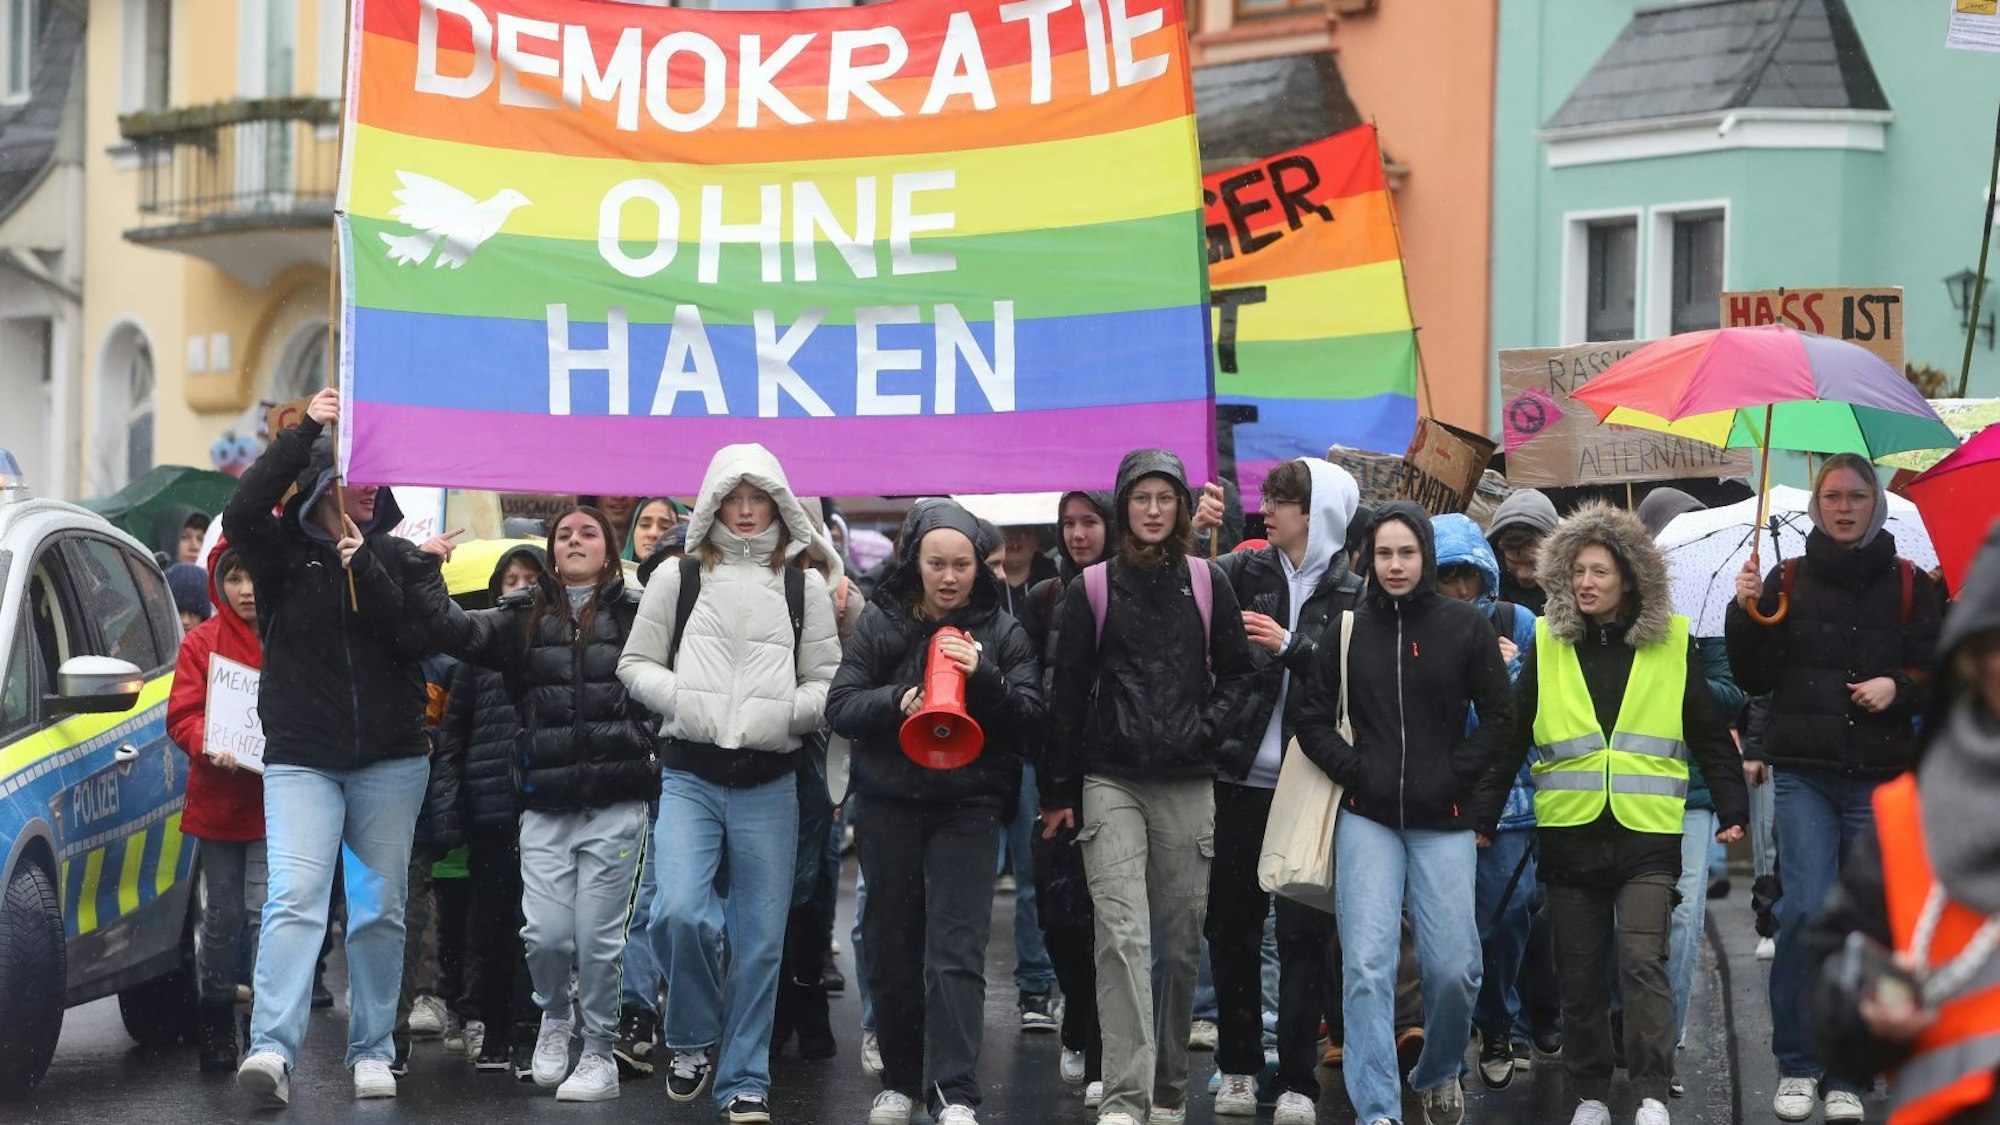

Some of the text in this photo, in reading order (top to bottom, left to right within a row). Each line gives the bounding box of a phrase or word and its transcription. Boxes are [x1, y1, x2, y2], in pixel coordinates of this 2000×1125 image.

[413, 0, 1171, 131] DEMOKRATIE
[598, 170, 957, 284] OHNE
[546, 300, 1016, 418] HAKEN
[1730, 293, 1900, 341] HASS IST
[213, 666, 260, 696] MENS
[73, 769, 121, 828] POLIZEI
